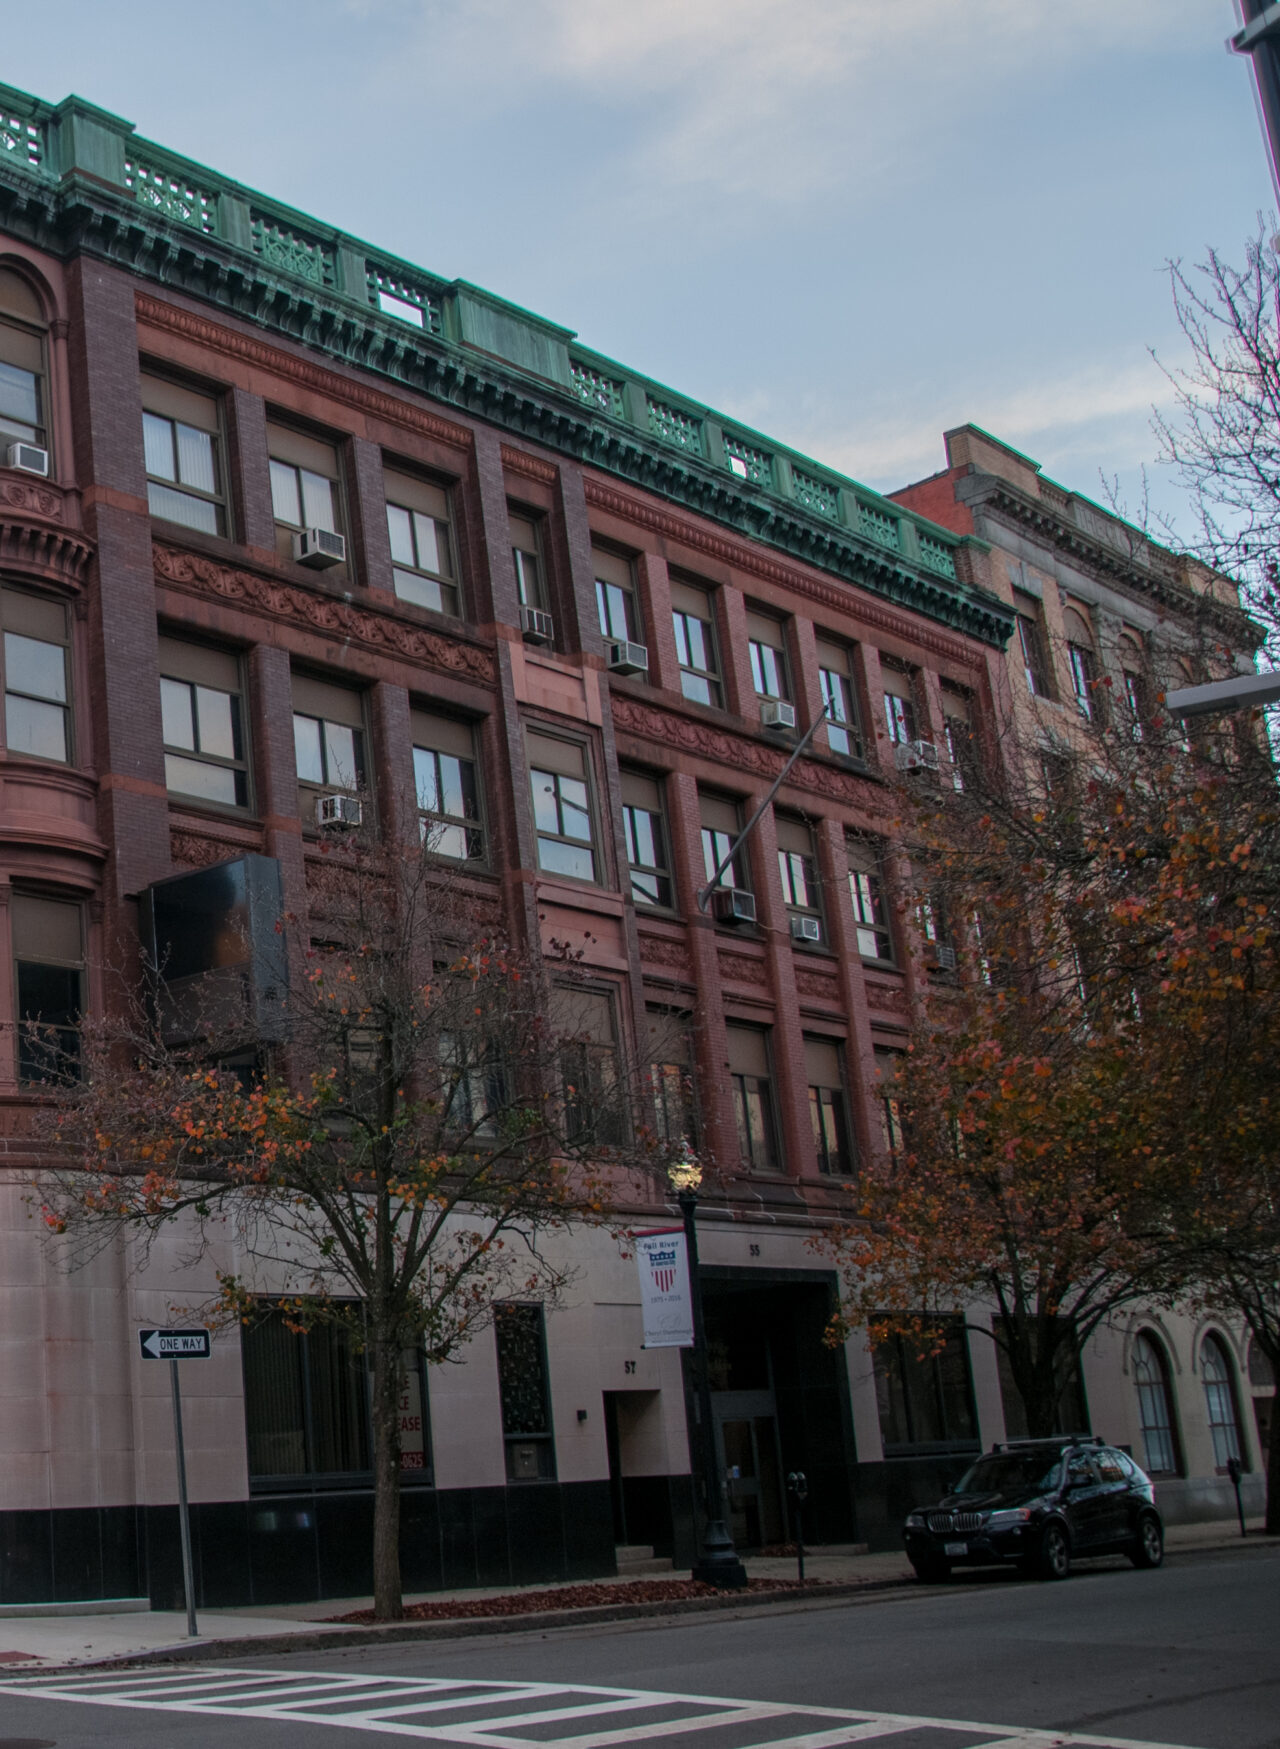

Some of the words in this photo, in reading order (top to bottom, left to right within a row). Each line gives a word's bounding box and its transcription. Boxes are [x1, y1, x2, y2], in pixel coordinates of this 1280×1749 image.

[749, 1244, 761, 1257] 55
[160, 1339, 180, 1350] ONE
[182, 1338, 202, 1350] WAY
[625, 1361, 636, 1374] 57
